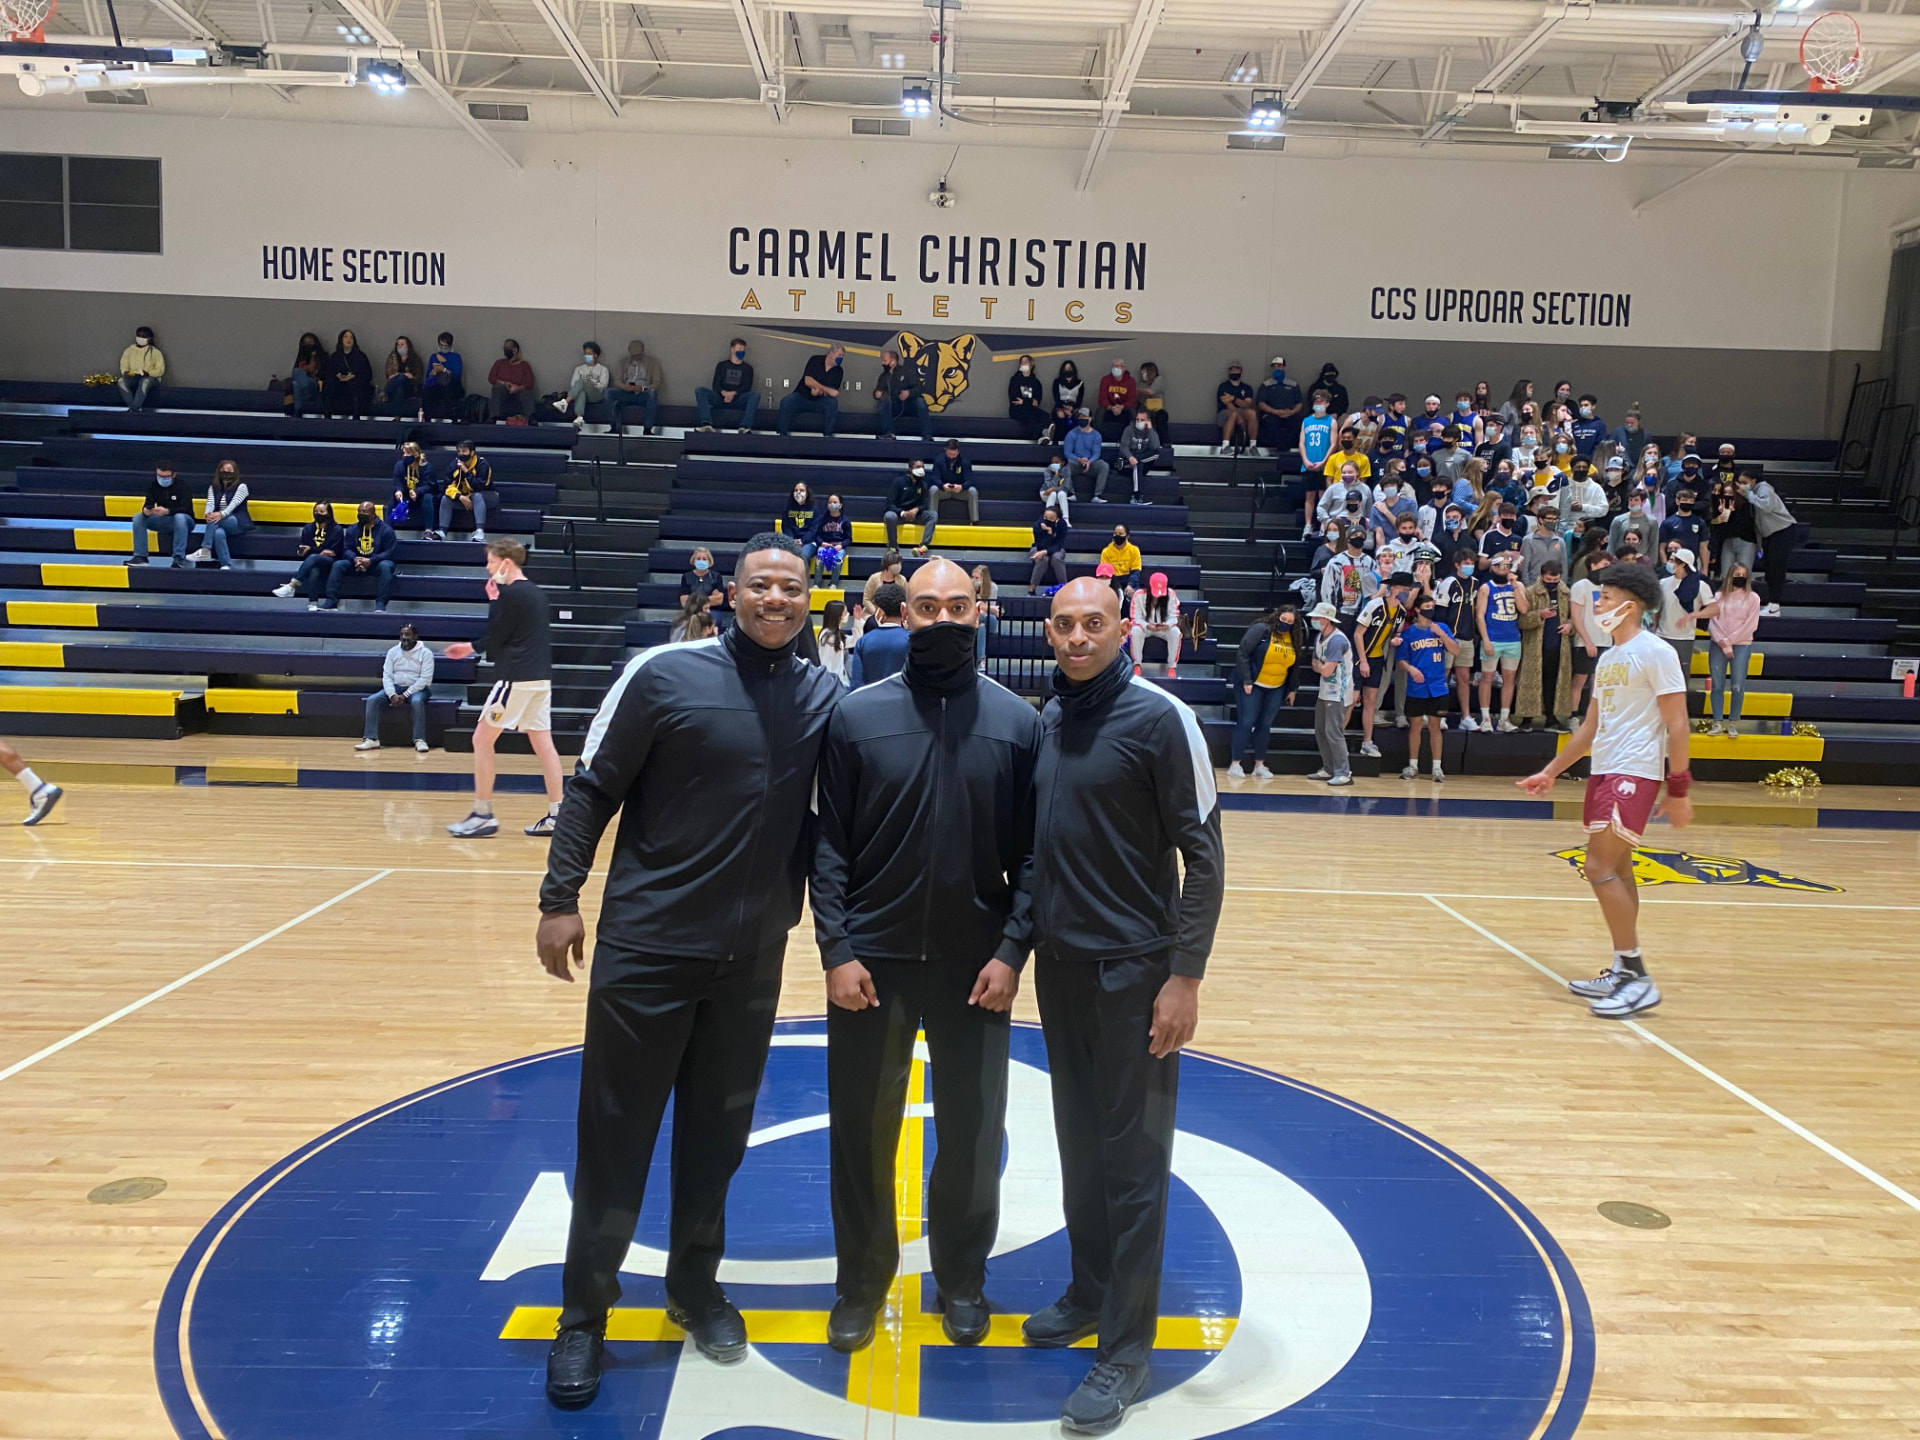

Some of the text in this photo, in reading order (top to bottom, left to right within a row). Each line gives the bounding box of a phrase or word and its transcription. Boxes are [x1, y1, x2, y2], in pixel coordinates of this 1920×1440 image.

[262, 245, 446, 287] HOME SECTION
[729, 227, 1148, 292] CARMEL CHRISTIAN
[740, 289, 1133, 325] ATHLETICS
[1370, 286, 1631, 328] CCS UPROAR SECTION
[1309, 432, 1321, 446] 33
[1496, 598, 1516, 615] 15
